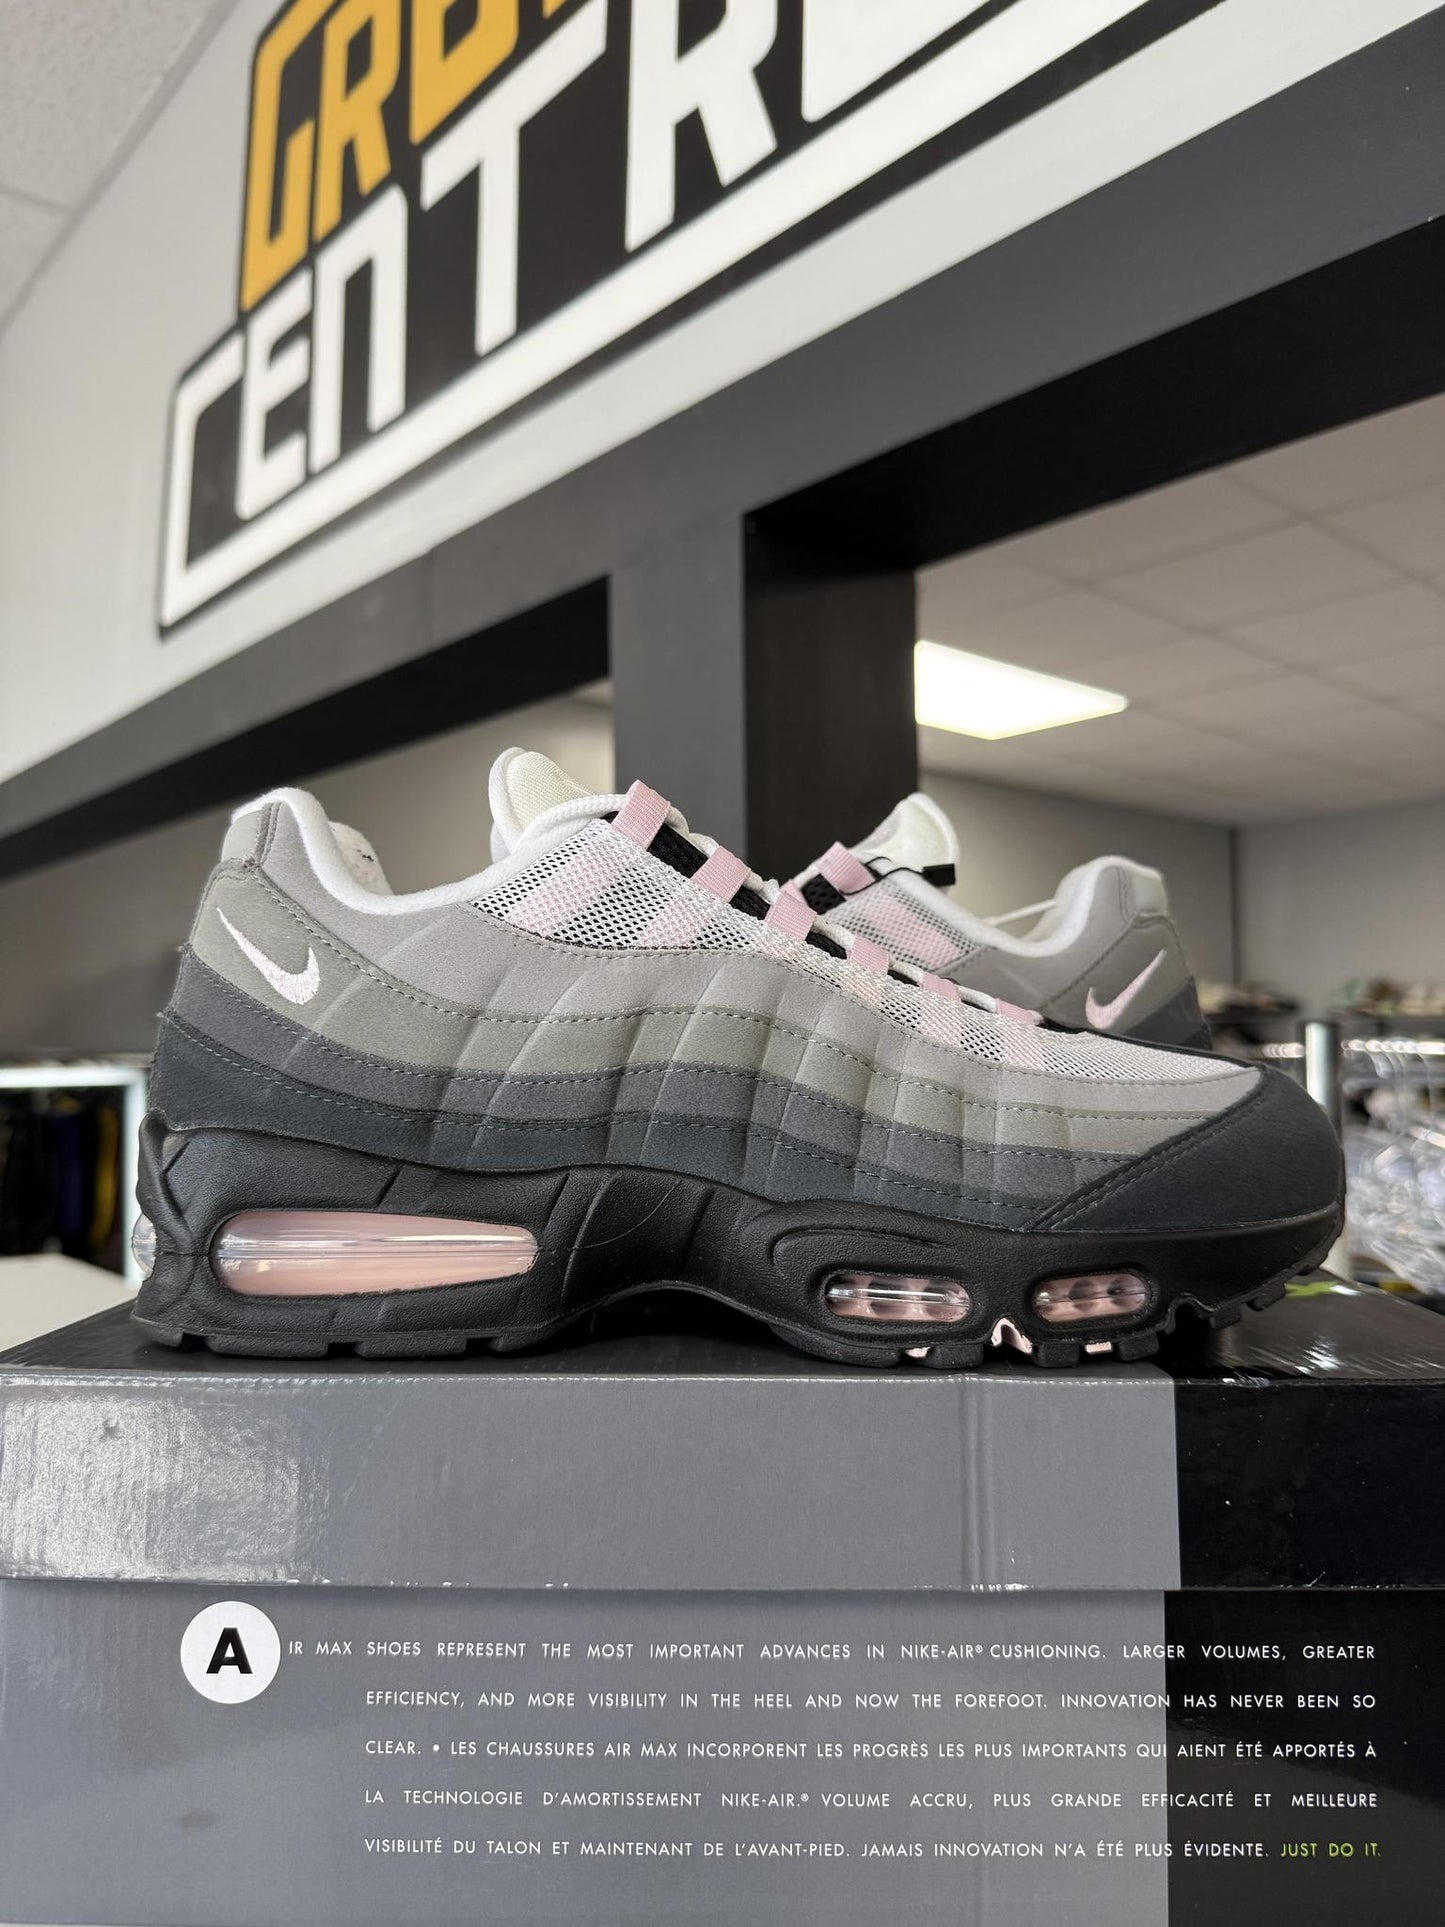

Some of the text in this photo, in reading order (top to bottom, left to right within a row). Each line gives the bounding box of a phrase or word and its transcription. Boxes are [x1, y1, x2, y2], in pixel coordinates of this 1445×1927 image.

[206, 1627, 253, 1675] A
[288, 1640, 304, 1655] IR
[315, 1640, 353, 1656] MAX
[366, 1640, 422, 1657] SHOES
[437, 1641, 527, 1658] REPRESENT
[541, 1642, 571, 1659] THE
[586, 1643, 634, 1659] MOST
[649, 1643, 745, 1660] IMPORTANT
[759, 1643, 851, 1660] ADVANCES
[866, 1643, 885, 1660] IN
[989, 1643, 1106, 1659] CUSHIONING.
[1122, 1643, 1186, 1660] LARGER
[1200, 1644, 1286, 1662] VOLUMES,
[1302, 1644, 1376, 1660] GREATER
[366, 1690, 1377, 1709] EFFICIENCY, AND MORE VISIBILITY IN THE HEEL AND NOW THE FOREFOOT. INNOVATION HAS NEVER BEEN SO
[365, 1738, 1377, 1759] CLEAR. LES CHAUSSURES AIR MAX INCORPORENT LES PROGRÈS LES PLUS IMPORTANTS QUI AIENT ÉTÉ APPORTÉS À
[365, 1789, 385, 1804] LA
[403, 1789, 523, 1806] TECHNOLOGIE
[820, 1792, 890, 1808] VOLUME
[909, 1792, 973, 1810] ACCRU,
[993, 1792, 1032, 1808] PLUS
[1050, 1792, 1122, 1808] GRANDE
[1141, 1788, 1234, 1808] EFFICACITÉ
[1254, 1792, 1272, 1808] ET
[1291, 1792, 1378, 1808] MEILLEURE
[364, 1835, 443, 1854] VISIBILITÉ
[453, 1839, 476, 1854] DU
[486, 1840, 541, 1855] TALON
[552, 1841, 570, 1855] ET
[580, 1841, 693, 1857] MAINTENANT
[703, 1842, 724, 1857] DE
[861, 1842, 924, 1857] JAMAIS
[934, 1842, 1043, 1857] INNOVATION
[1096, 1837, 1124, 1857] ÉTÉ
[1134, 1842, 1173, 1858] PLUS
[1183, 1838, 1269, 1858] ÉVIDENTE.
[1280, 1842, 1318, 1858] JUST
[1328, 1842, 1355, 1858] DO
[1364, 1842, 1381, 1857] IT.
